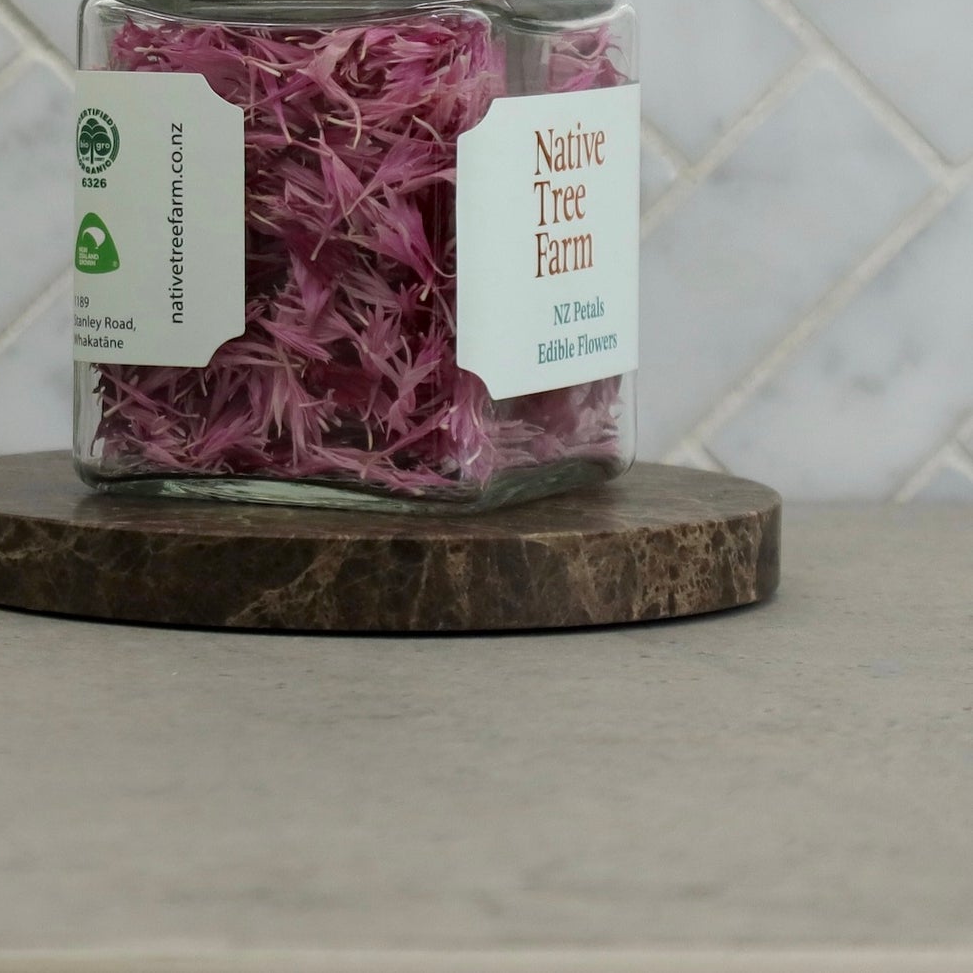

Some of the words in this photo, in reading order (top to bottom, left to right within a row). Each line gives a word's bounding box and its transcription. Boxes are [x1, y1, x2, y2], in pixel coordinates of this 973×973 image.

[534, 121, 605, 176] Native
[82, 177, 108, 189] 6326
[167, 122, 184, 324] nativetreefarm.co.nz
[533, 180, 586, 227] Tree
[534, 232, 594, 279] Farm
[105, 316, 137, 332] Road,
[553, 302, 571, 326] NZ
[573, 296, 605, 322] Petals
[537, 336, 575, 365] Edible
[577, 331, 618, 357] Flowers
